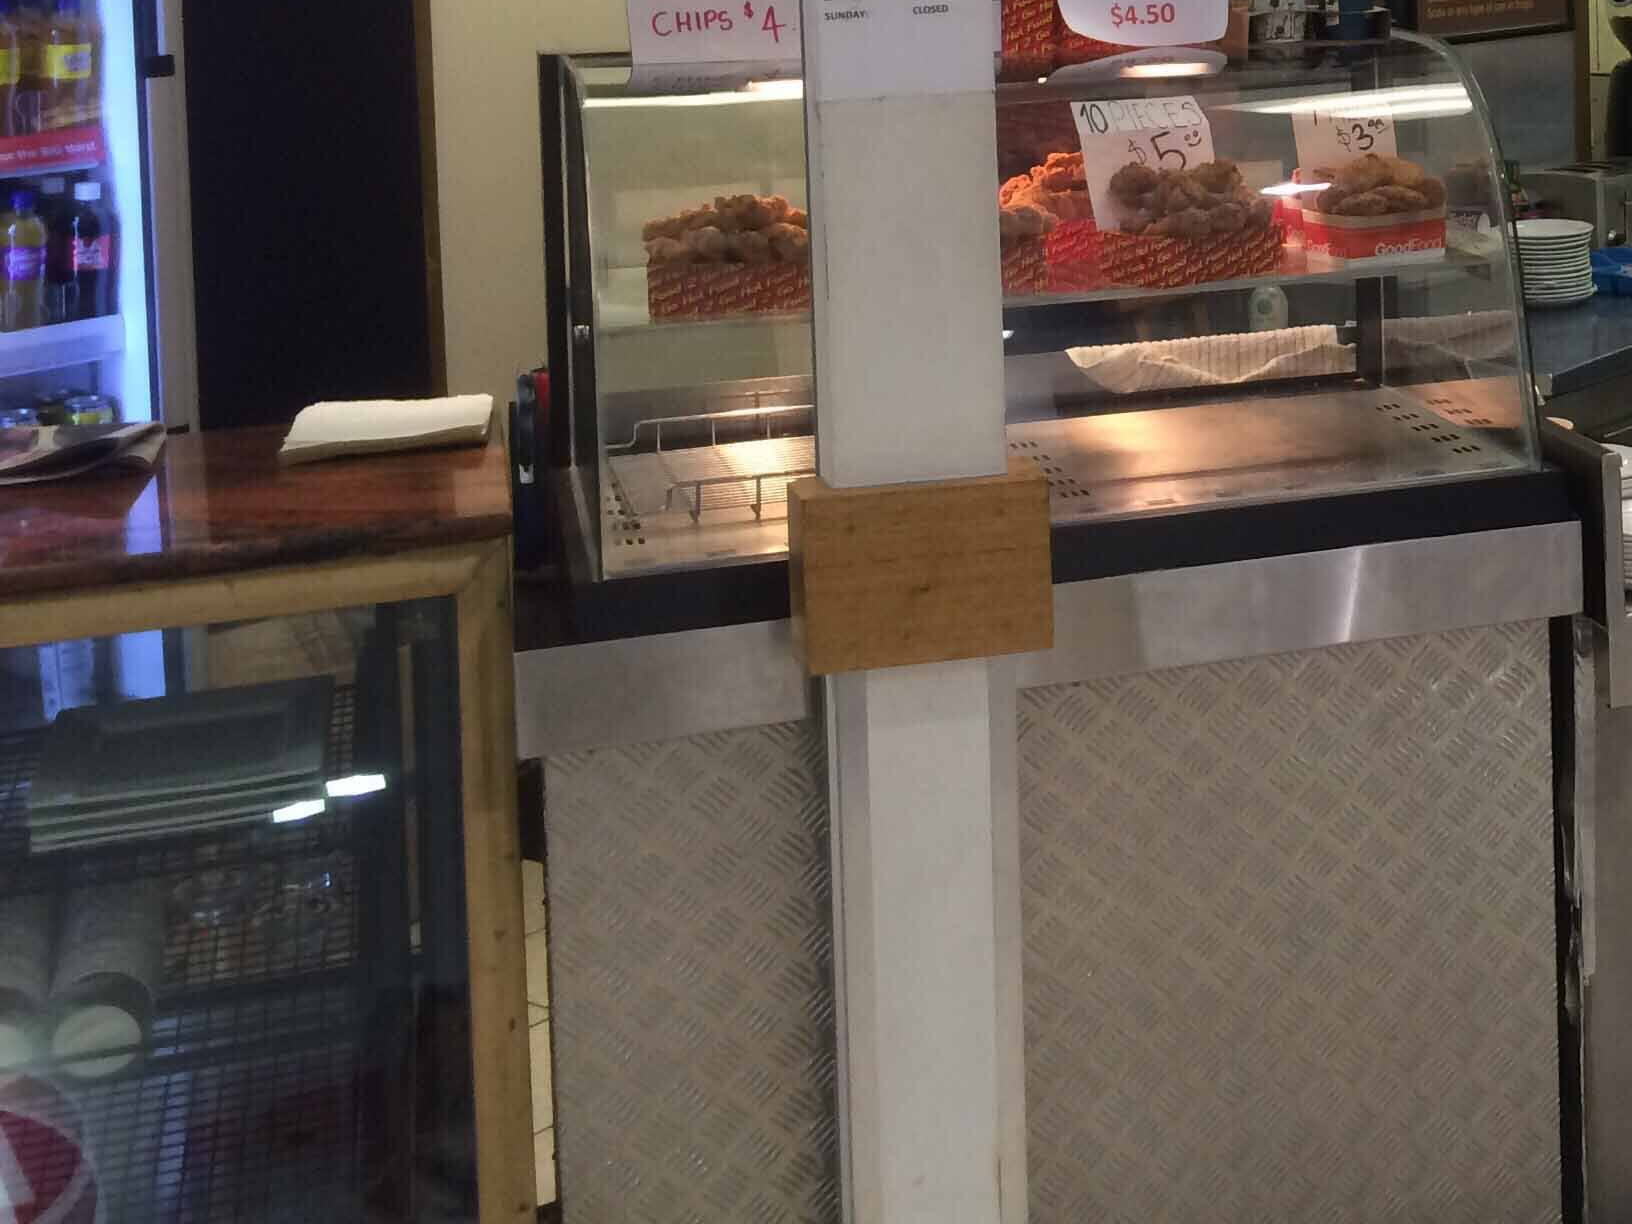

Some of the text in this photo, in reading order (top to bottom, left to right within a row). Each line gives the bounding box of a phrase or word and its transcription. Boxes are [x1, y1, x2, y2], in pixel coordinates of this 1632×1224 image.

[912, 3, 949, 15] CLOSED
[1110, 2, 1175, 27] $4.50
[651, 9, 733, 37] CHIPS
[1080, 101, 1202, 134] 10 PIECES
